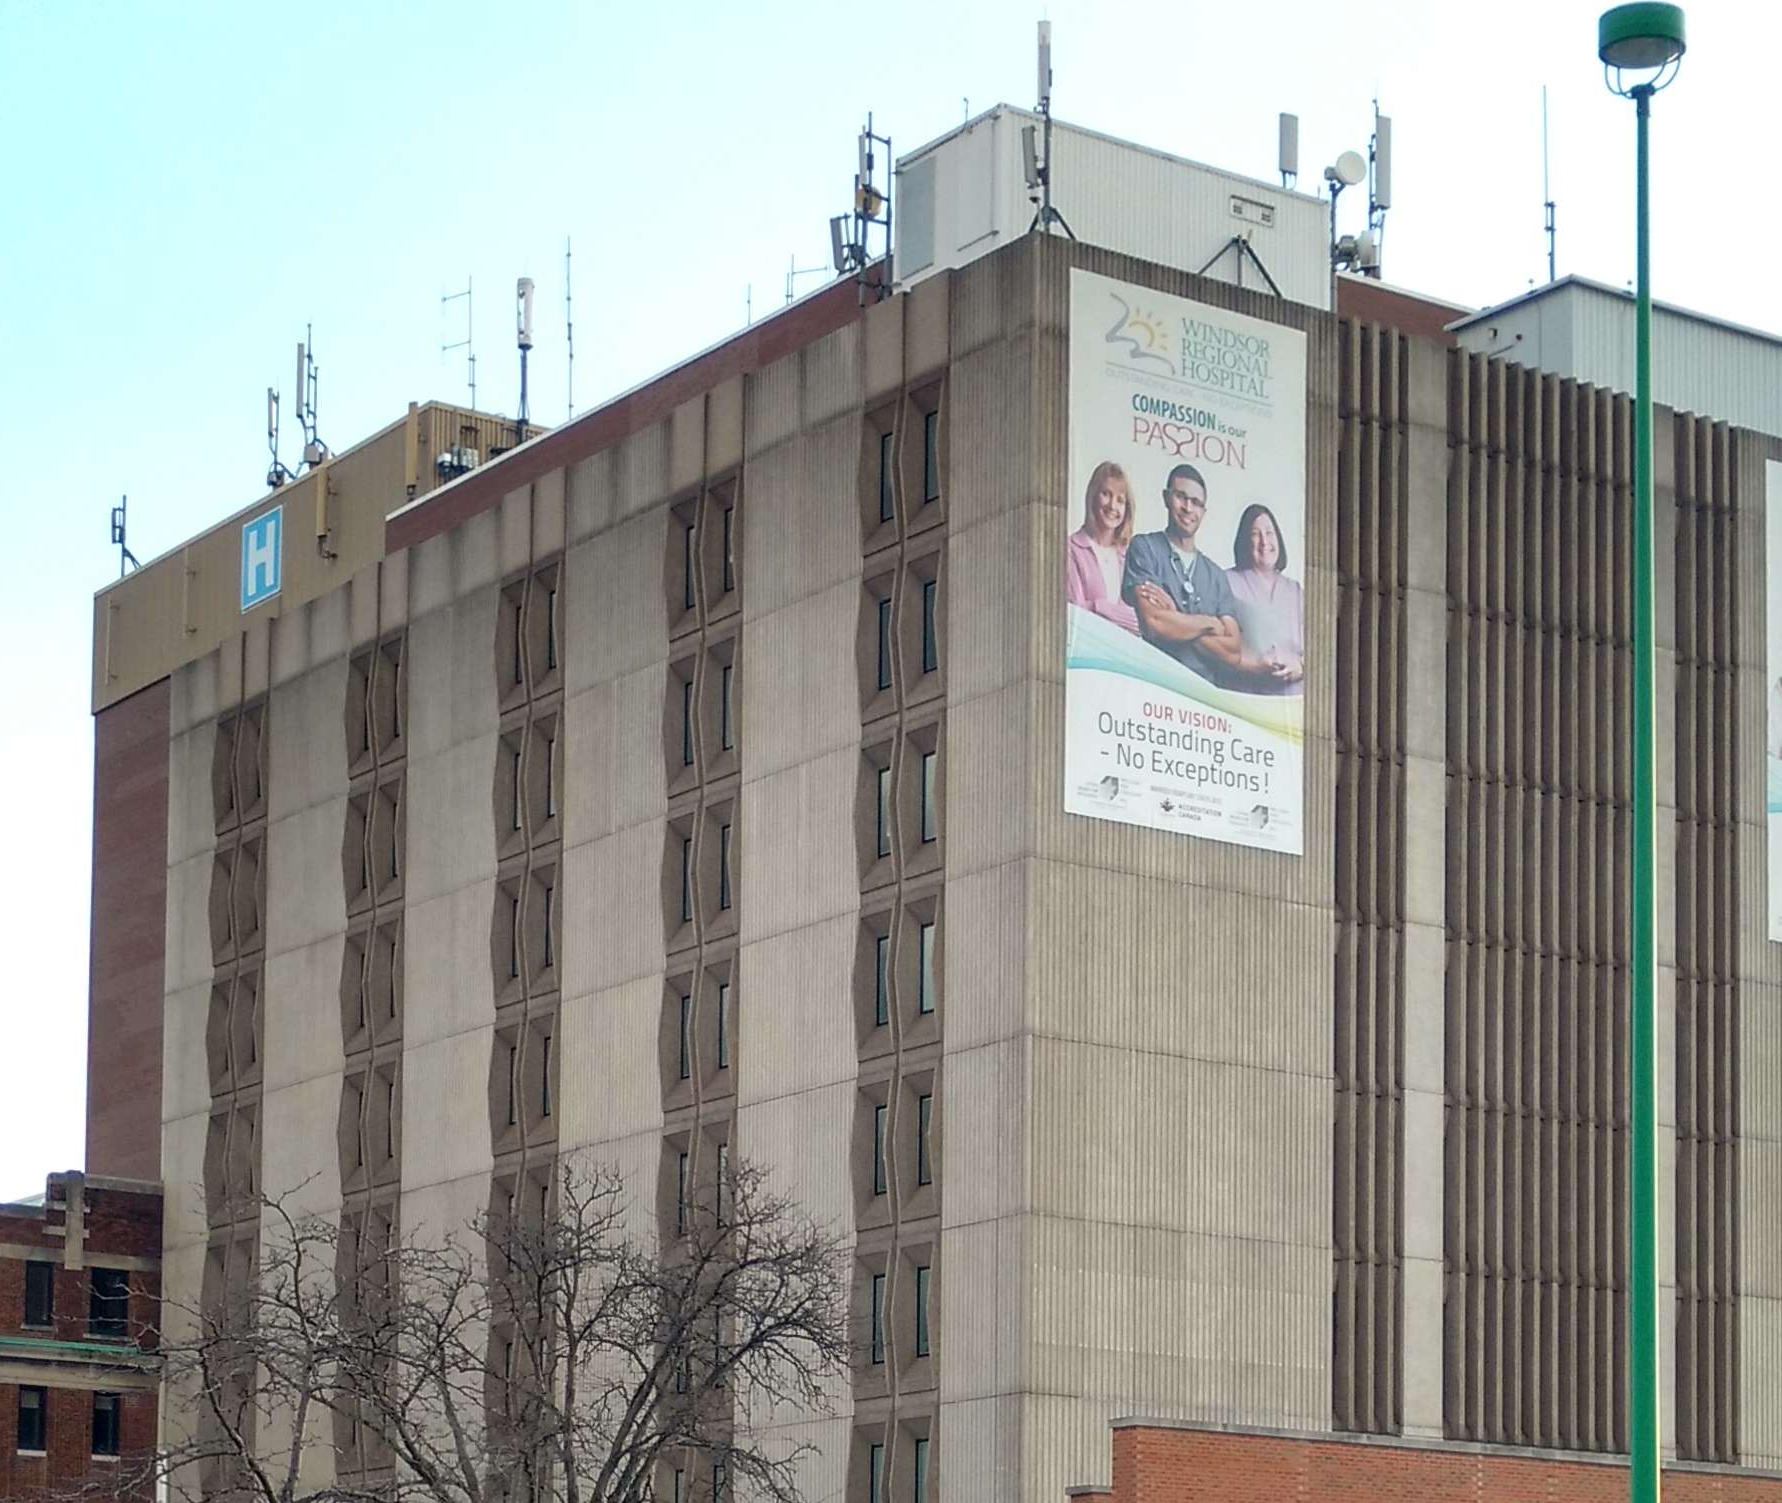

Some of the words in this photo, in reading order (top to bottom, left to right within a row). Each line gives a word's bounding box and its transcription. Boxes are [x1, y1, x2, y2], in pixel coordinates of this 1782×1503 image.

[1182, 318, 1269, 358] WINDSOR
[1182, 338, 1274, 380] REGIONAL
[1182, 358, 1269, 399] HOSPITAL
[1132, 393, 1216, 430] COMPASSION
[1132, 416, 1247, 470] PASSION
[1143, 702, 1174, 722] OUR
[1178, 709, 1233, 734] VISION:
[1098, 711, 1226, 764] Outstanding
[1230, 739, 1275, 768] Care
[1117, 743, 1145, 769] No
